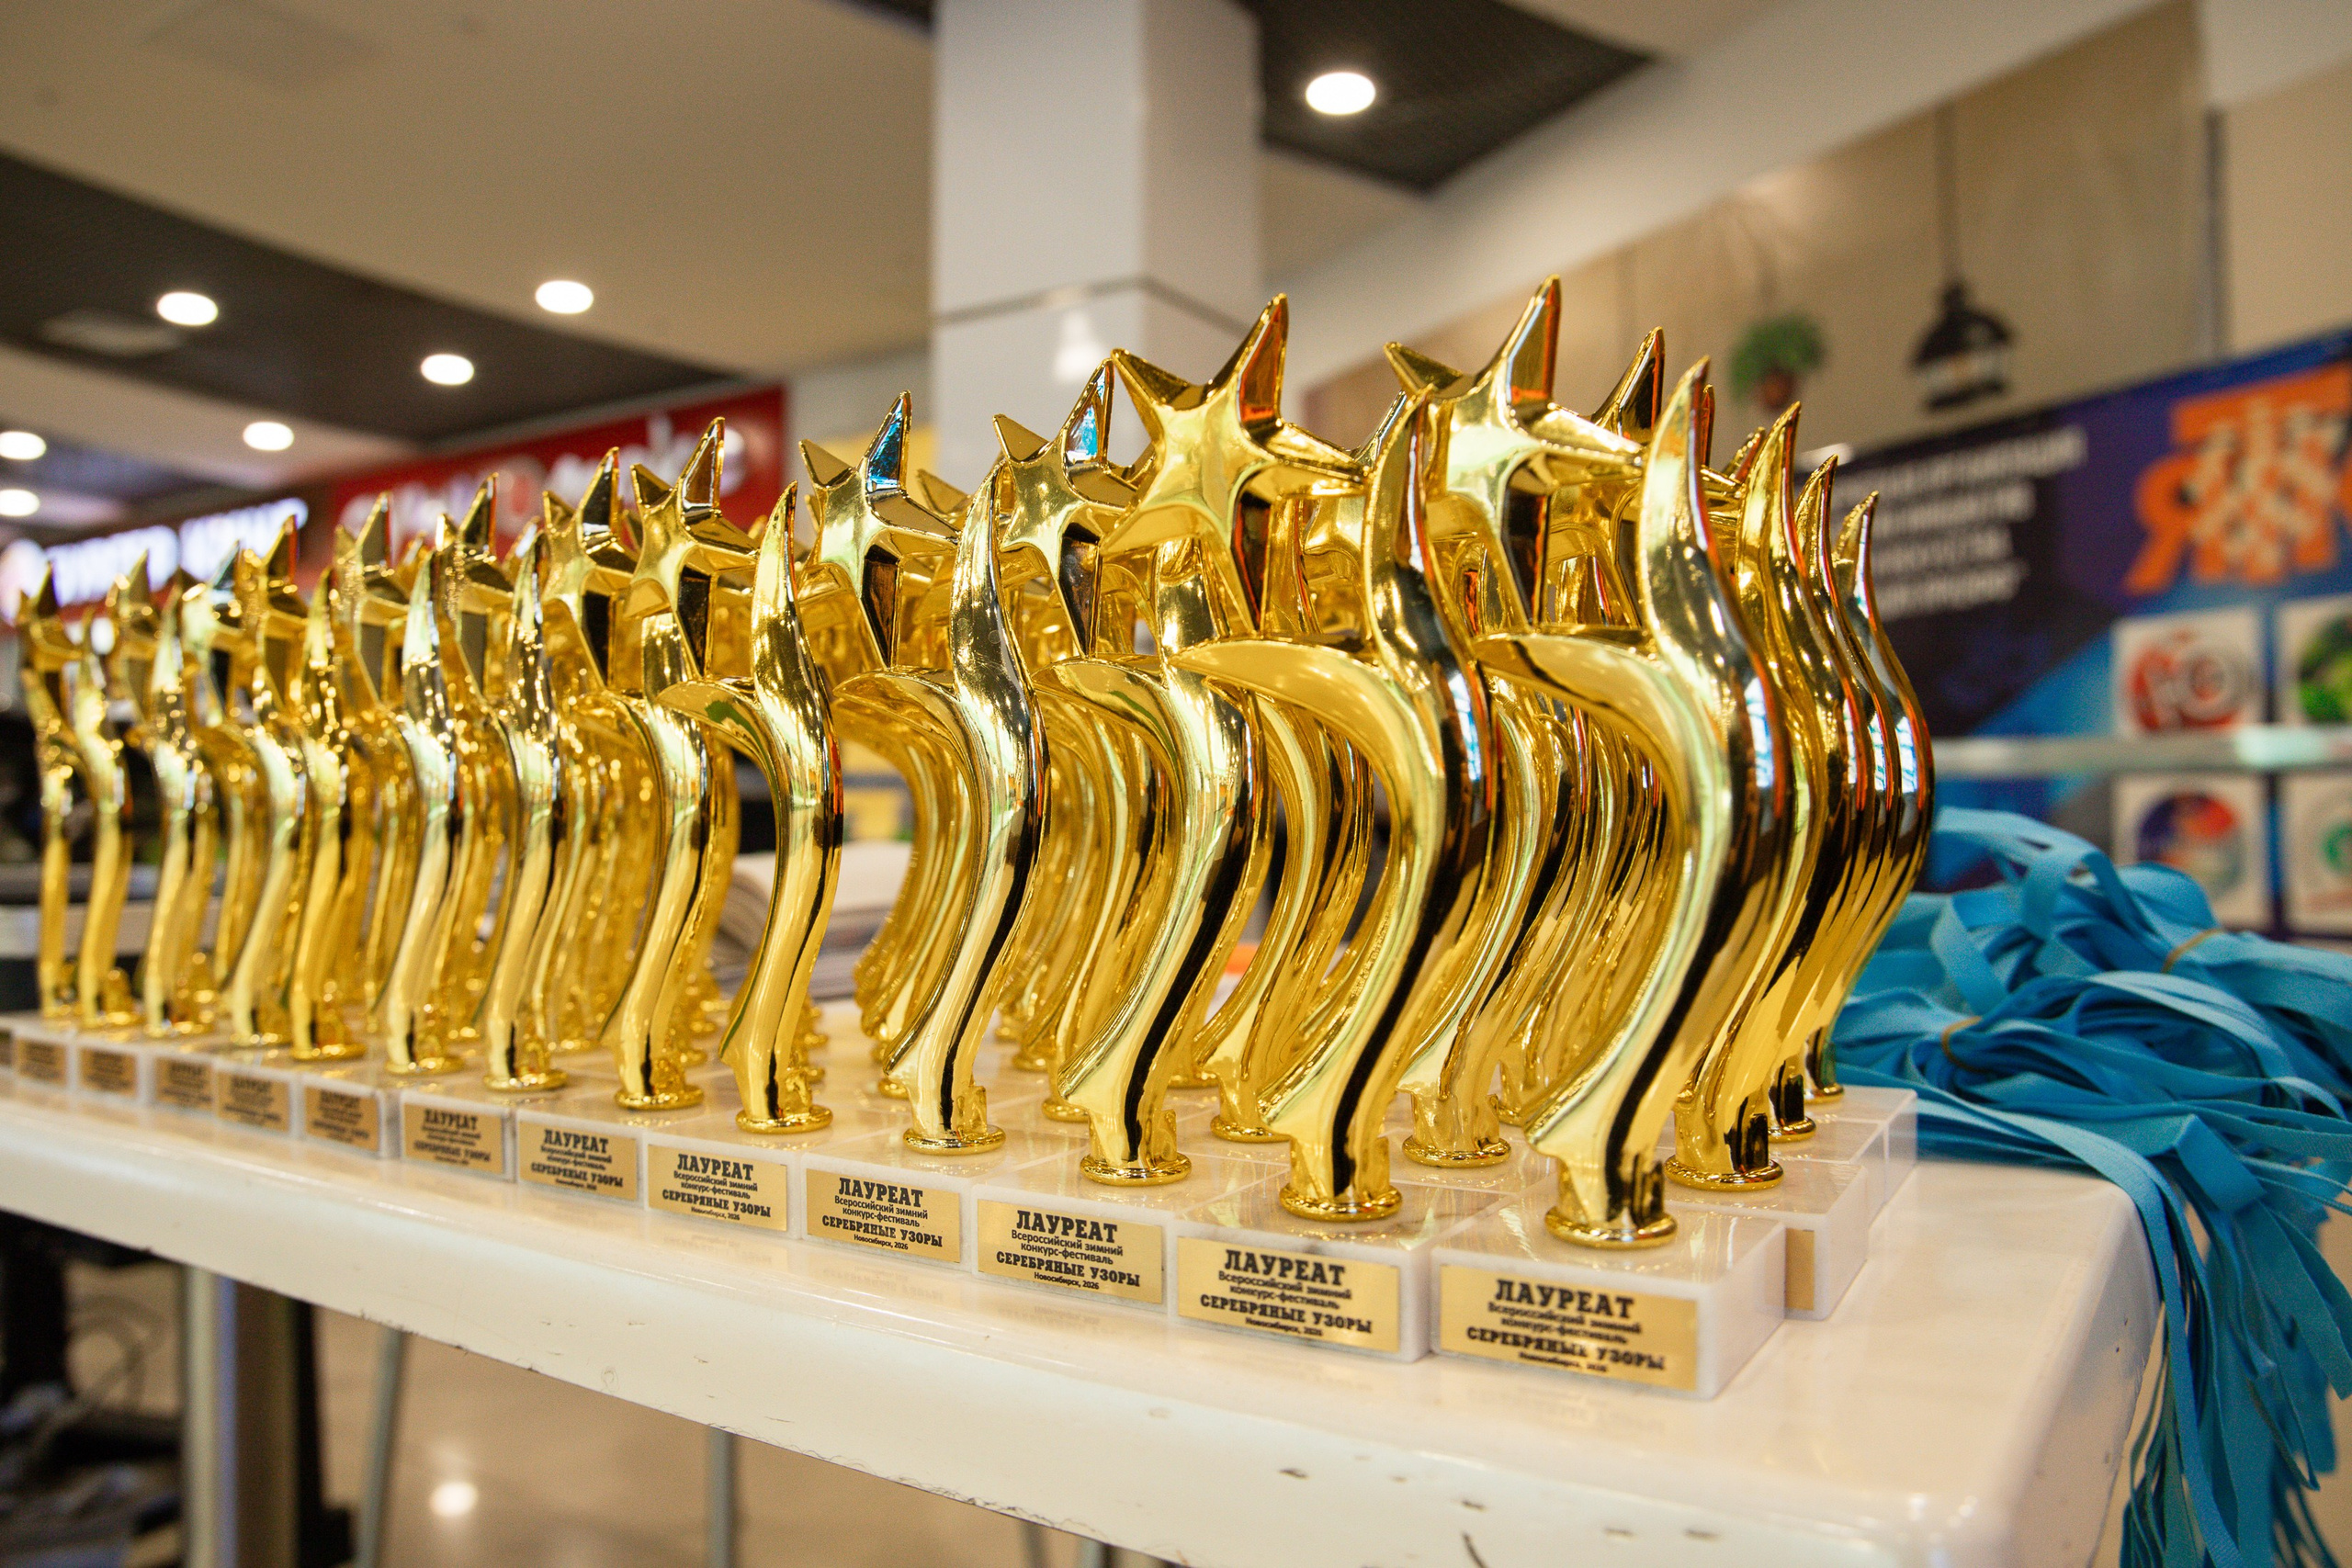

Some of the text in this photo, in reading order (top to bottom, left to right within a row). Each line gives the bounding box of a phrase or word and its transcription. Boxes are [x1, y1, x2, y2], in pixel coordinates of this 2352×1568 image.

[677, 1154, 753, 1180] ЛАУРЕАТ
[673, 1170, 758, 1191] Всероссийский зимний
[681, 1181, 751, 1199] конкурс-фестиваль
[839, 1178, 922, 1207] ЛАУРЕАТ
[662, 1190, 771, 1217] СЕРЕБРЯНЫЕ УЗОРЫ
[835, 1195, 928, 1219] Всероссийский зимний
[842, 1208, 920, 1227] конкурс-фестиваль
[1017, 1210, 1117, 1243] ЛАУРЕАТ
[822, 1215, 943, 1247] СЕРЕБРЯНЫЕ УЗОРЫ
[854, 1235, 893, 1248] Новосибирск,
[1012, 1230, 1123, 1256] Всероссийский зимний
[1021, 1243, 1114, 1265] конкурс-фестиваль
[1225, 1249, 1345, 1285] ЛАУРЕАТ
[997, 1251, 1139, 1286] СЕРЕБРЯНЫЕ УЗОРЫ
[1035, 1272, 1099, 1290] Новосибирск, 2026
[1219, 1270, 1303, 1292] Всероссийский
[1230, 1286, 1340, 1309] конкурс-фестиваль
[1495, 1279, 1634, 1318] ЛАУРЕАТ
[1201, 1294, 1372, 1333] СЕРЕБРЯНЫЕ УЗОРЫ
[1467, 1326, 1588, 1358] СЕРЕБРЯНЫЕ
[1598, 1347, 1666, 1370] УЗОРЫ
